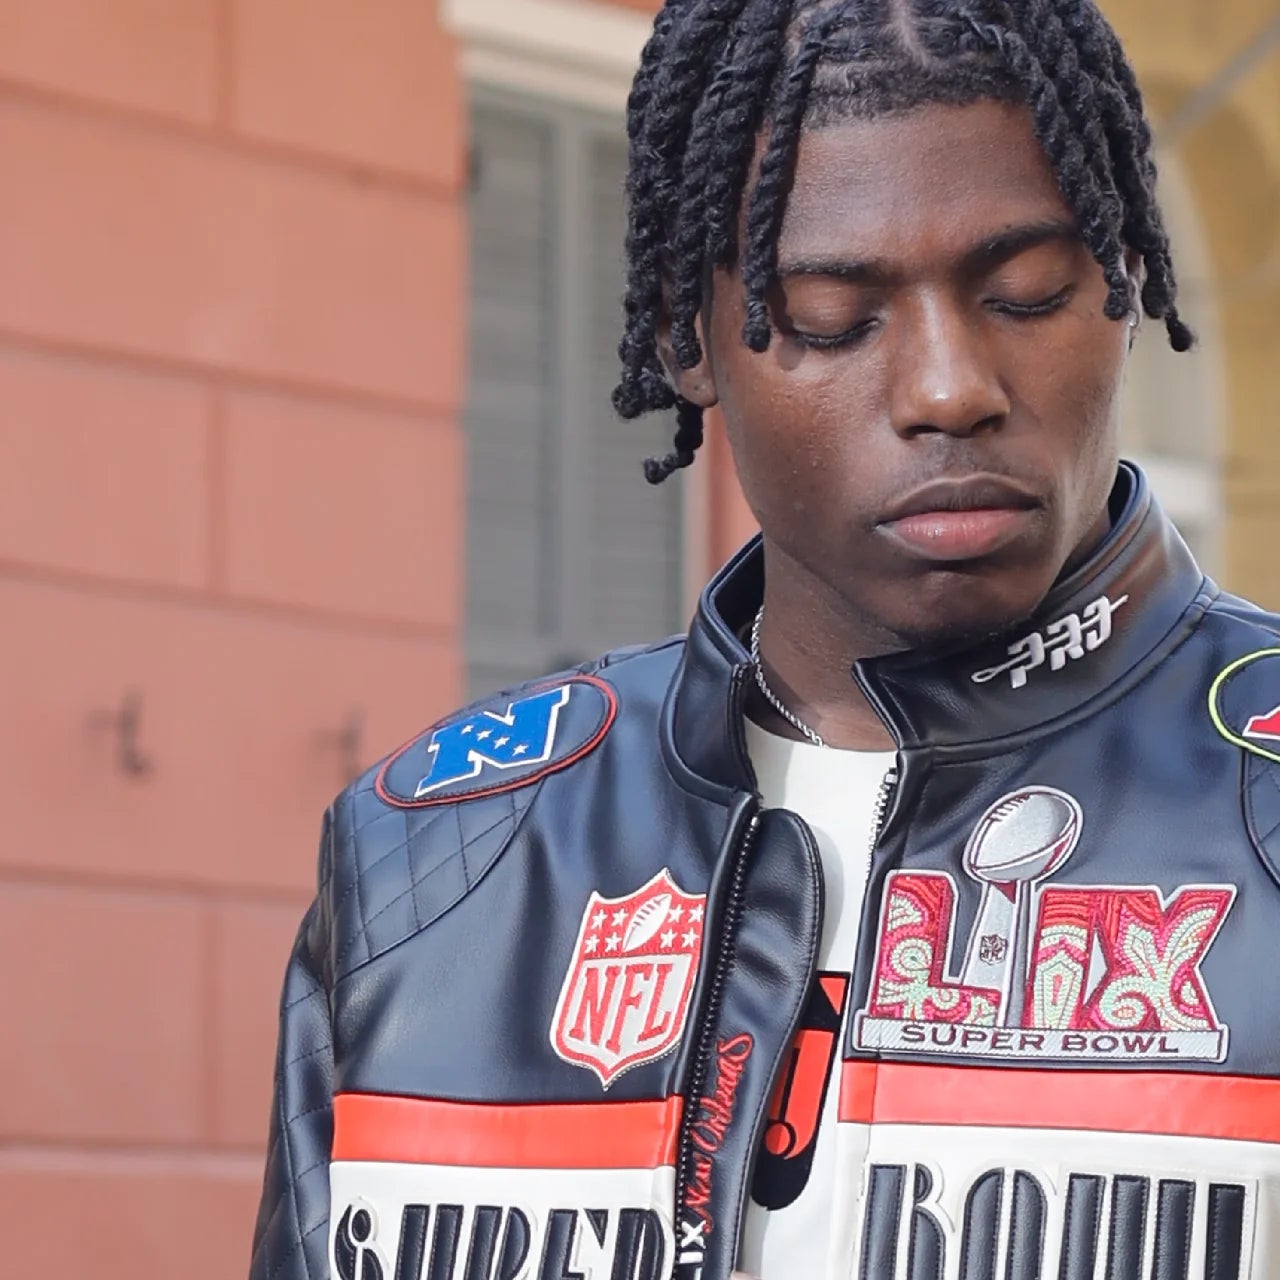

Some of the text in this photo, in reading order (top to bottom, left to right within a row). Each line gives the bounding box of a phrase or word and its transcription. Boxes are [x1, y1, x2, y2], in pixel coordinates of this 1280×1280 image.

[971, 594, 1128, 689] PRO
[568, 962, 678, 1042] NFL
[902, 1023, 1179, 1054] SUPER BOWL
[691, 1032, 754, 1152] Orleans
